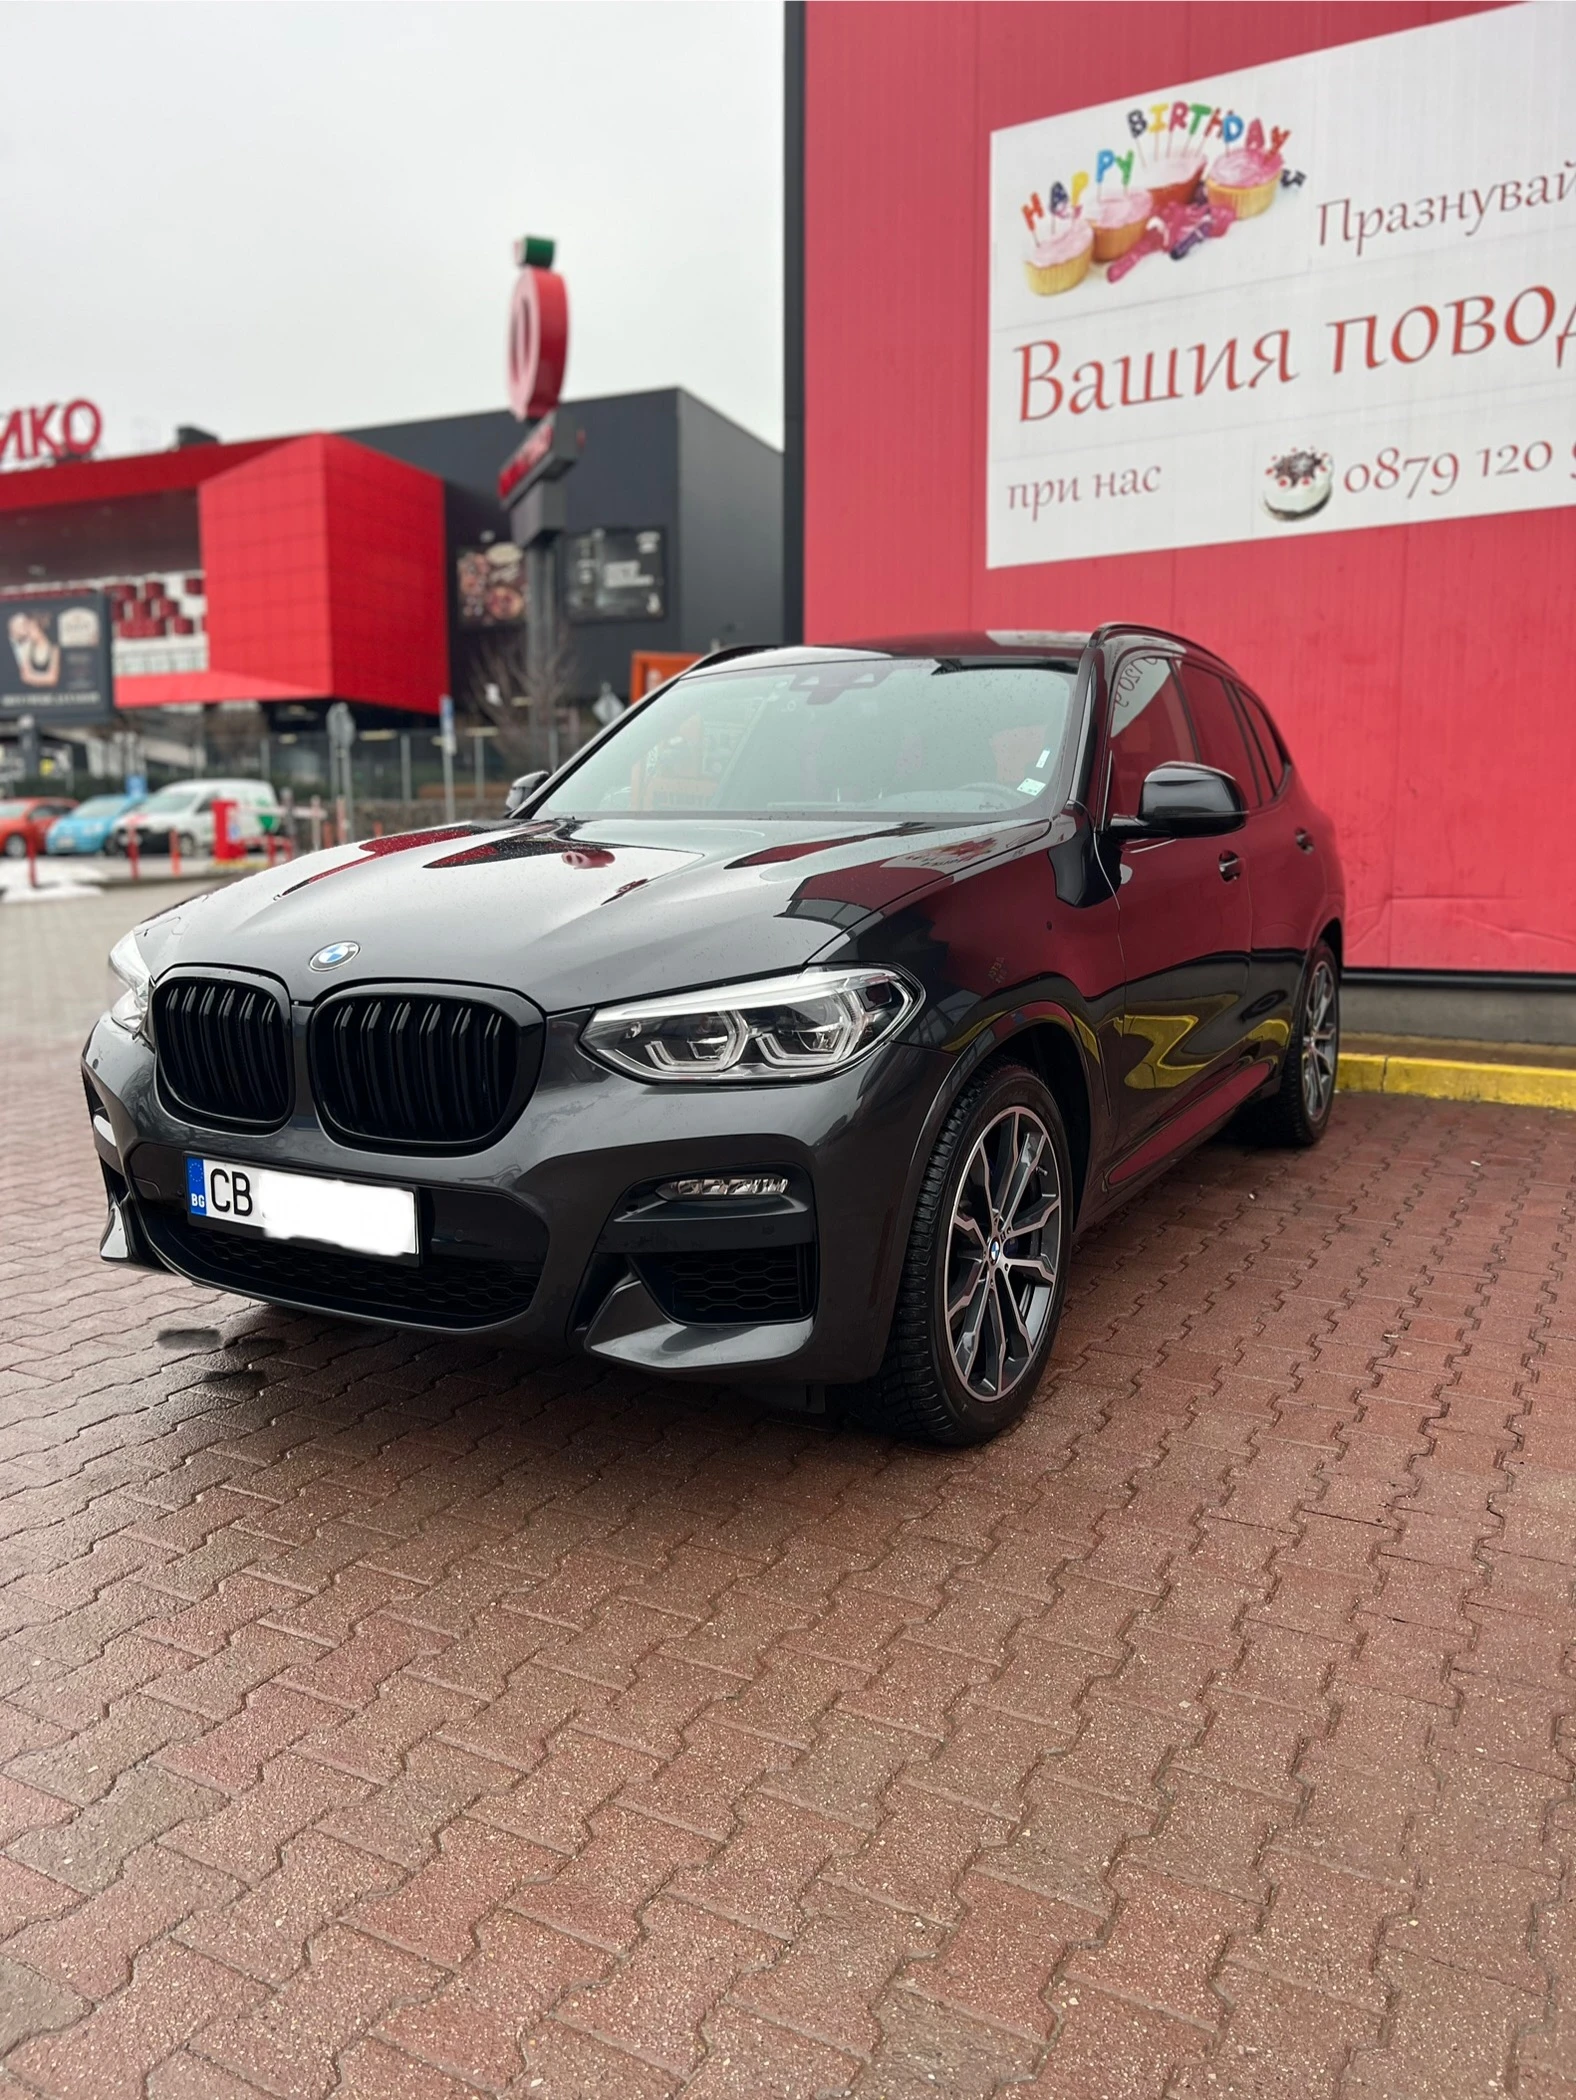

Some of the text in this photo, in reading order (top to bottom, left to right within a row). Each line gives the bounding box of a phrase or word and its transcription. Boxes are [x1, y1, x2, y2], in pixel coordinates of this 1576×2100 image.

[1022, 101, 1291, 231] HAPPY BIRTHDAY
[1013, 328, 1298, 423] Вашия
[1007, 464, 1162, 522] при нас
[1343, 447, 1460, 499] 0879
[1475, 440, 1554, 478] 120
[191, 1193, 205, 1208] BG
[210, 1167, 253, 1217] CB
